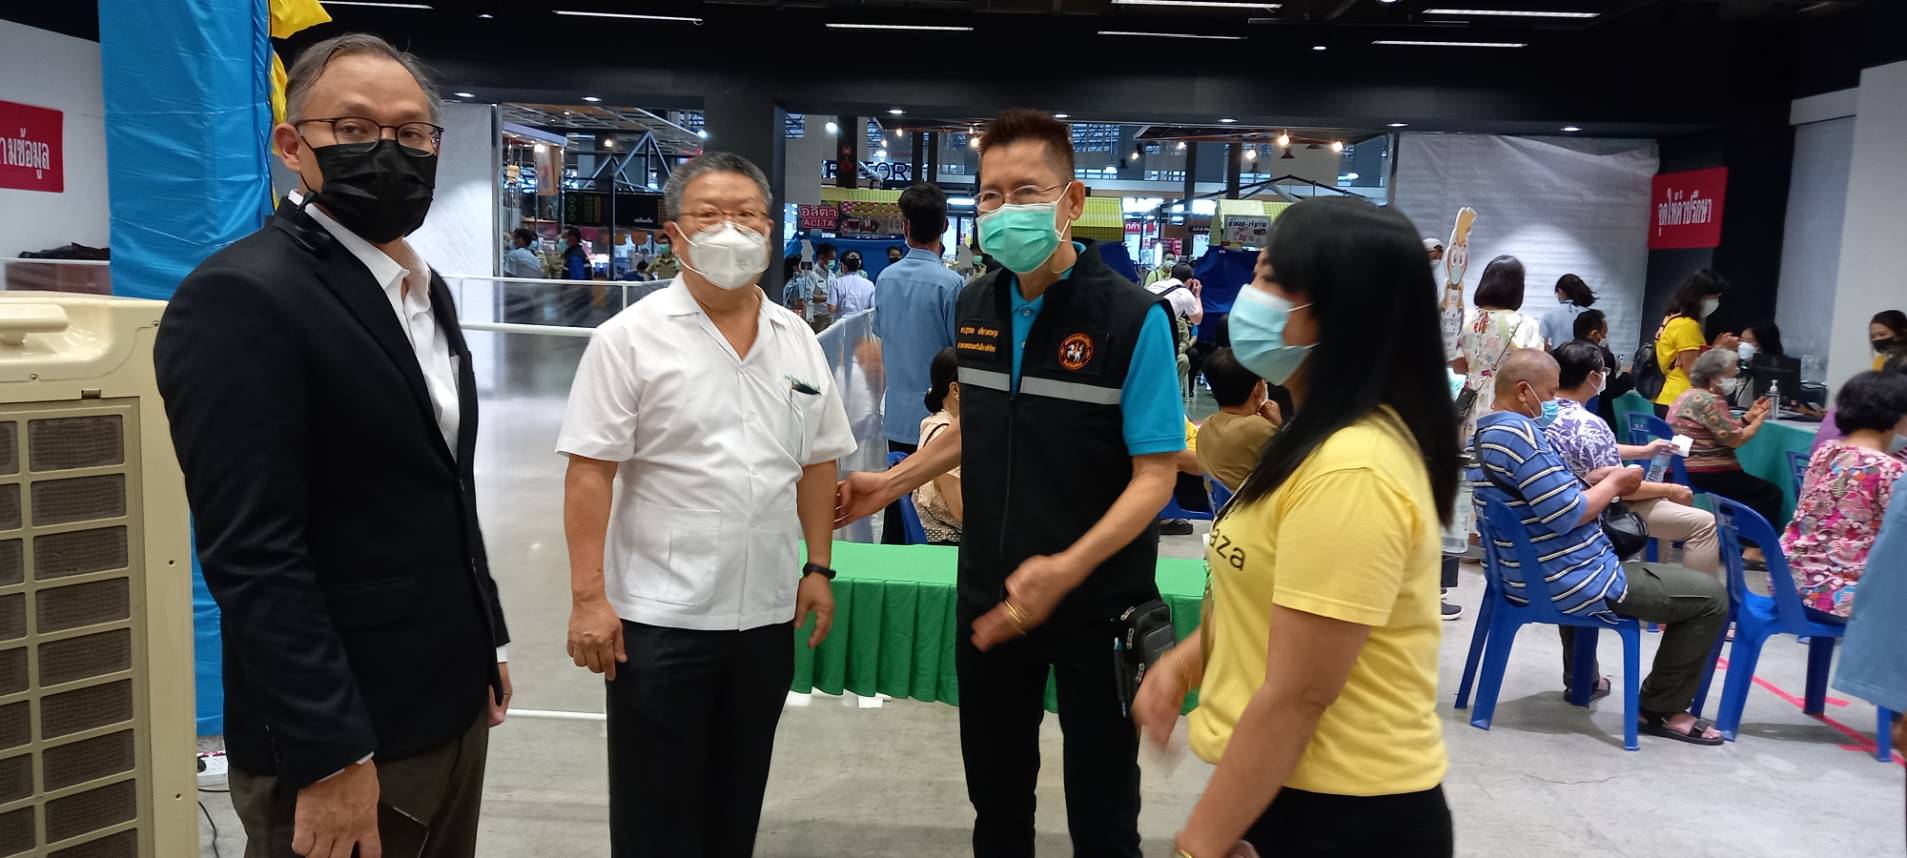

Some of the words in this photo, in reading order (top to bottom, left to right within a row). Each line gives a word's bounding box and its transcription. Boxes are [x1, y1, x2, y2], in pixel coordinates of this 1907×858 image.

[803, 218, 834, 227] ALITA
[1658, 187, 1713, 237] จุดให้คำปรึกษา
